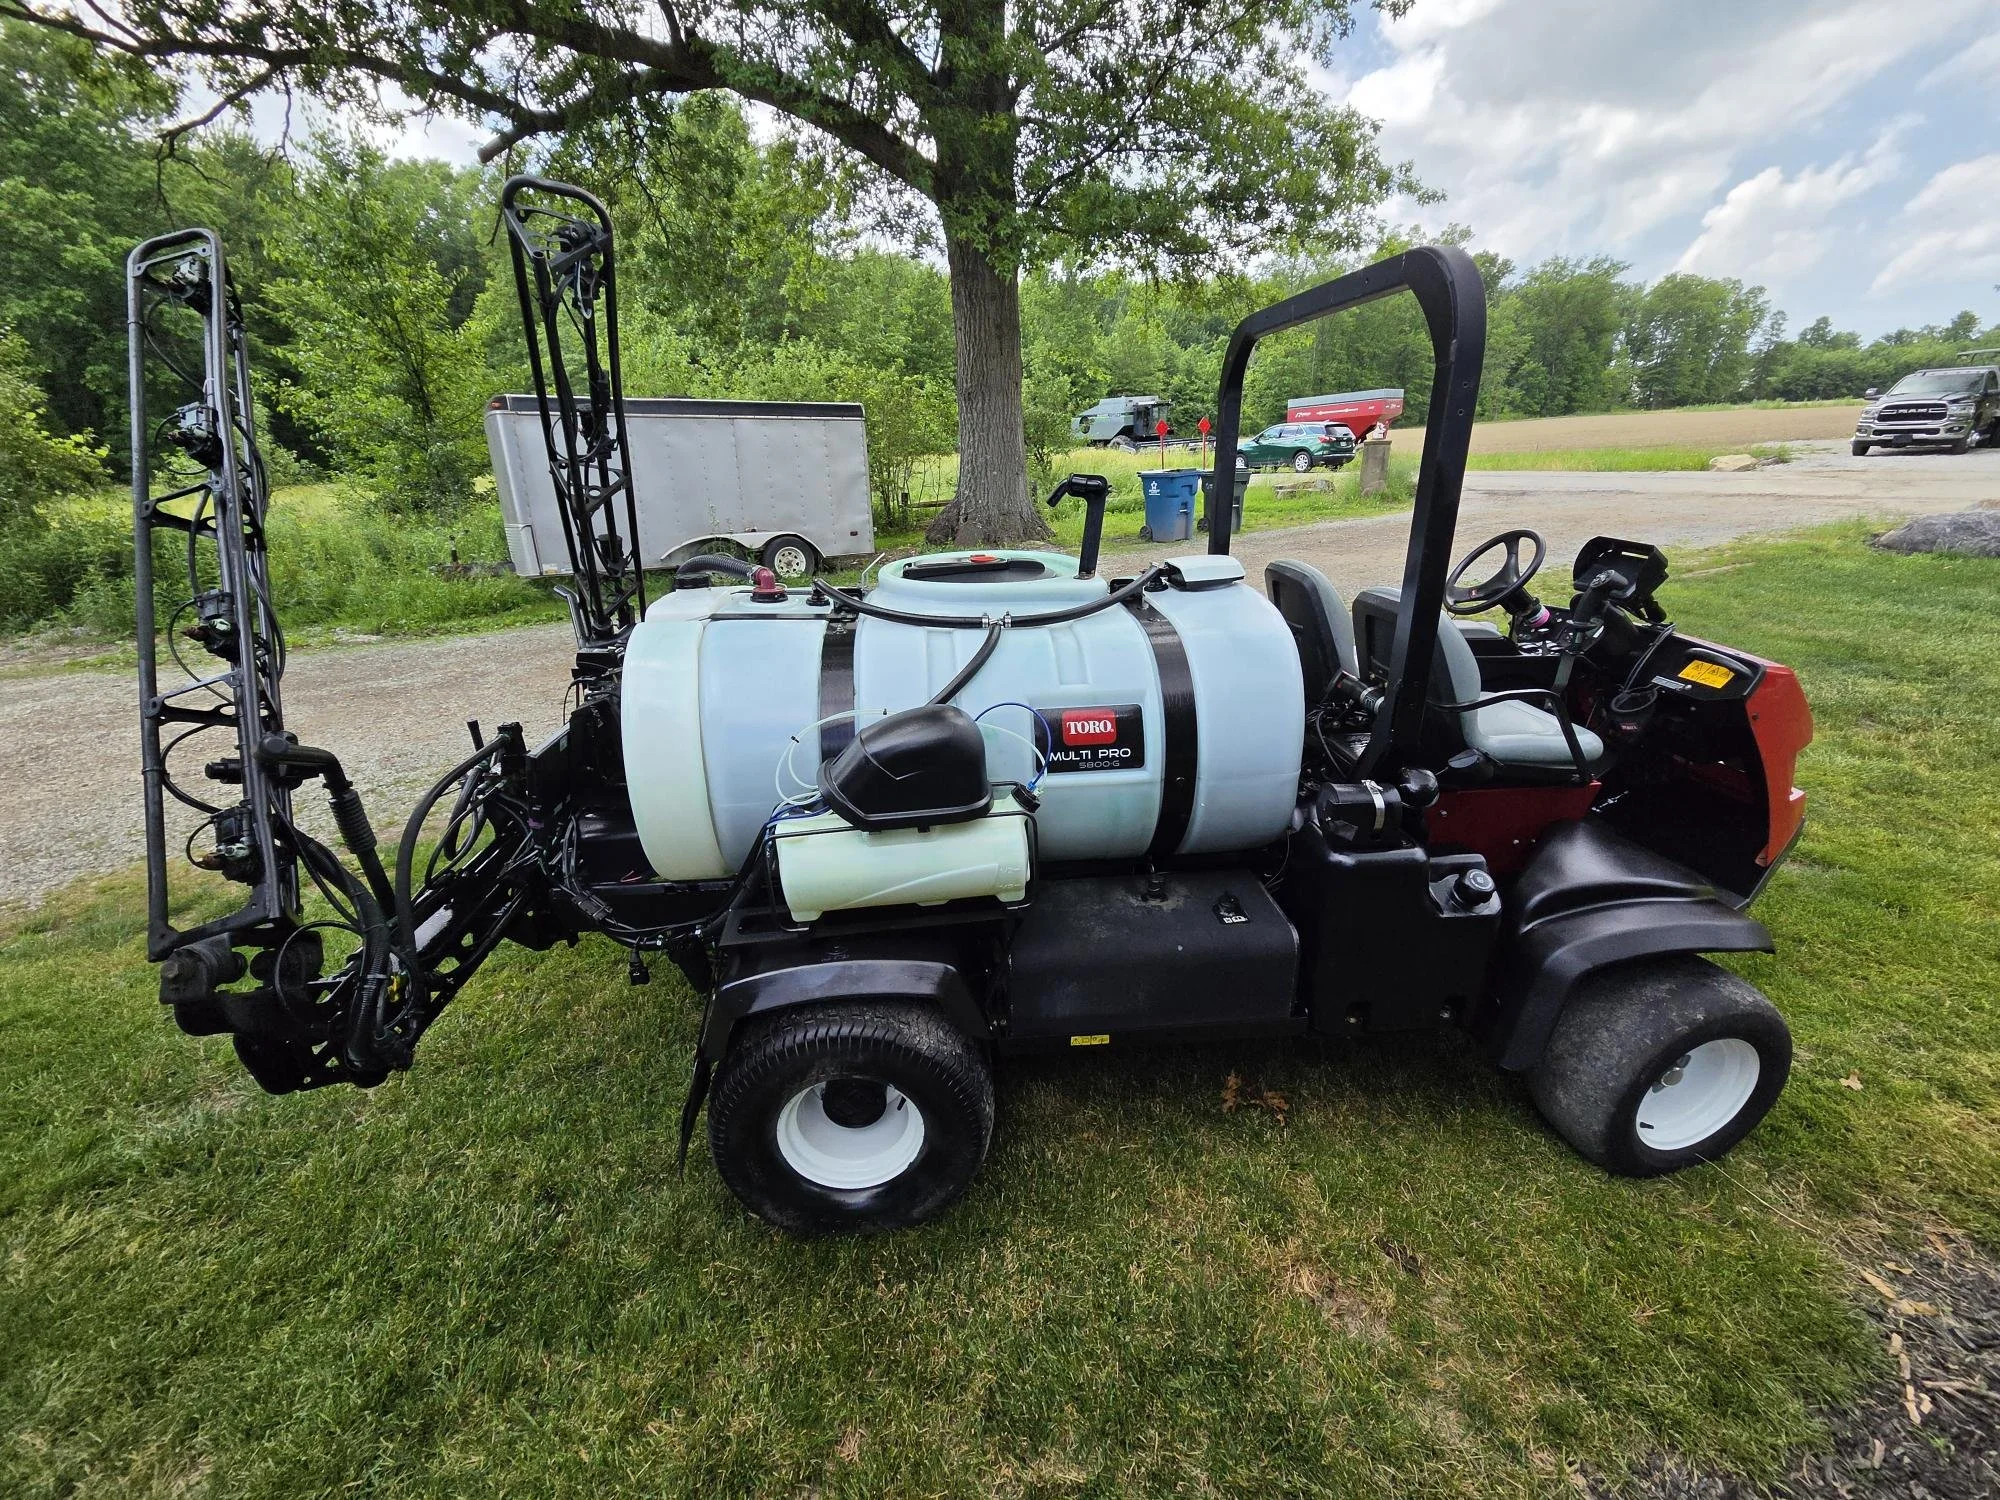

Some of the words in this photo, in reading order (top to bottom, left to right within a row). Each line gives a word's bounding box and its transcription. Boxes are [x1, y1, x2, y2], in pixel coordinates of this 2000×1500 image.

[1066, 719, 1113, 735] TORO
[1049, 750, 1091, 762] MULTI
[1098, 748, 1131, 759] PRO
